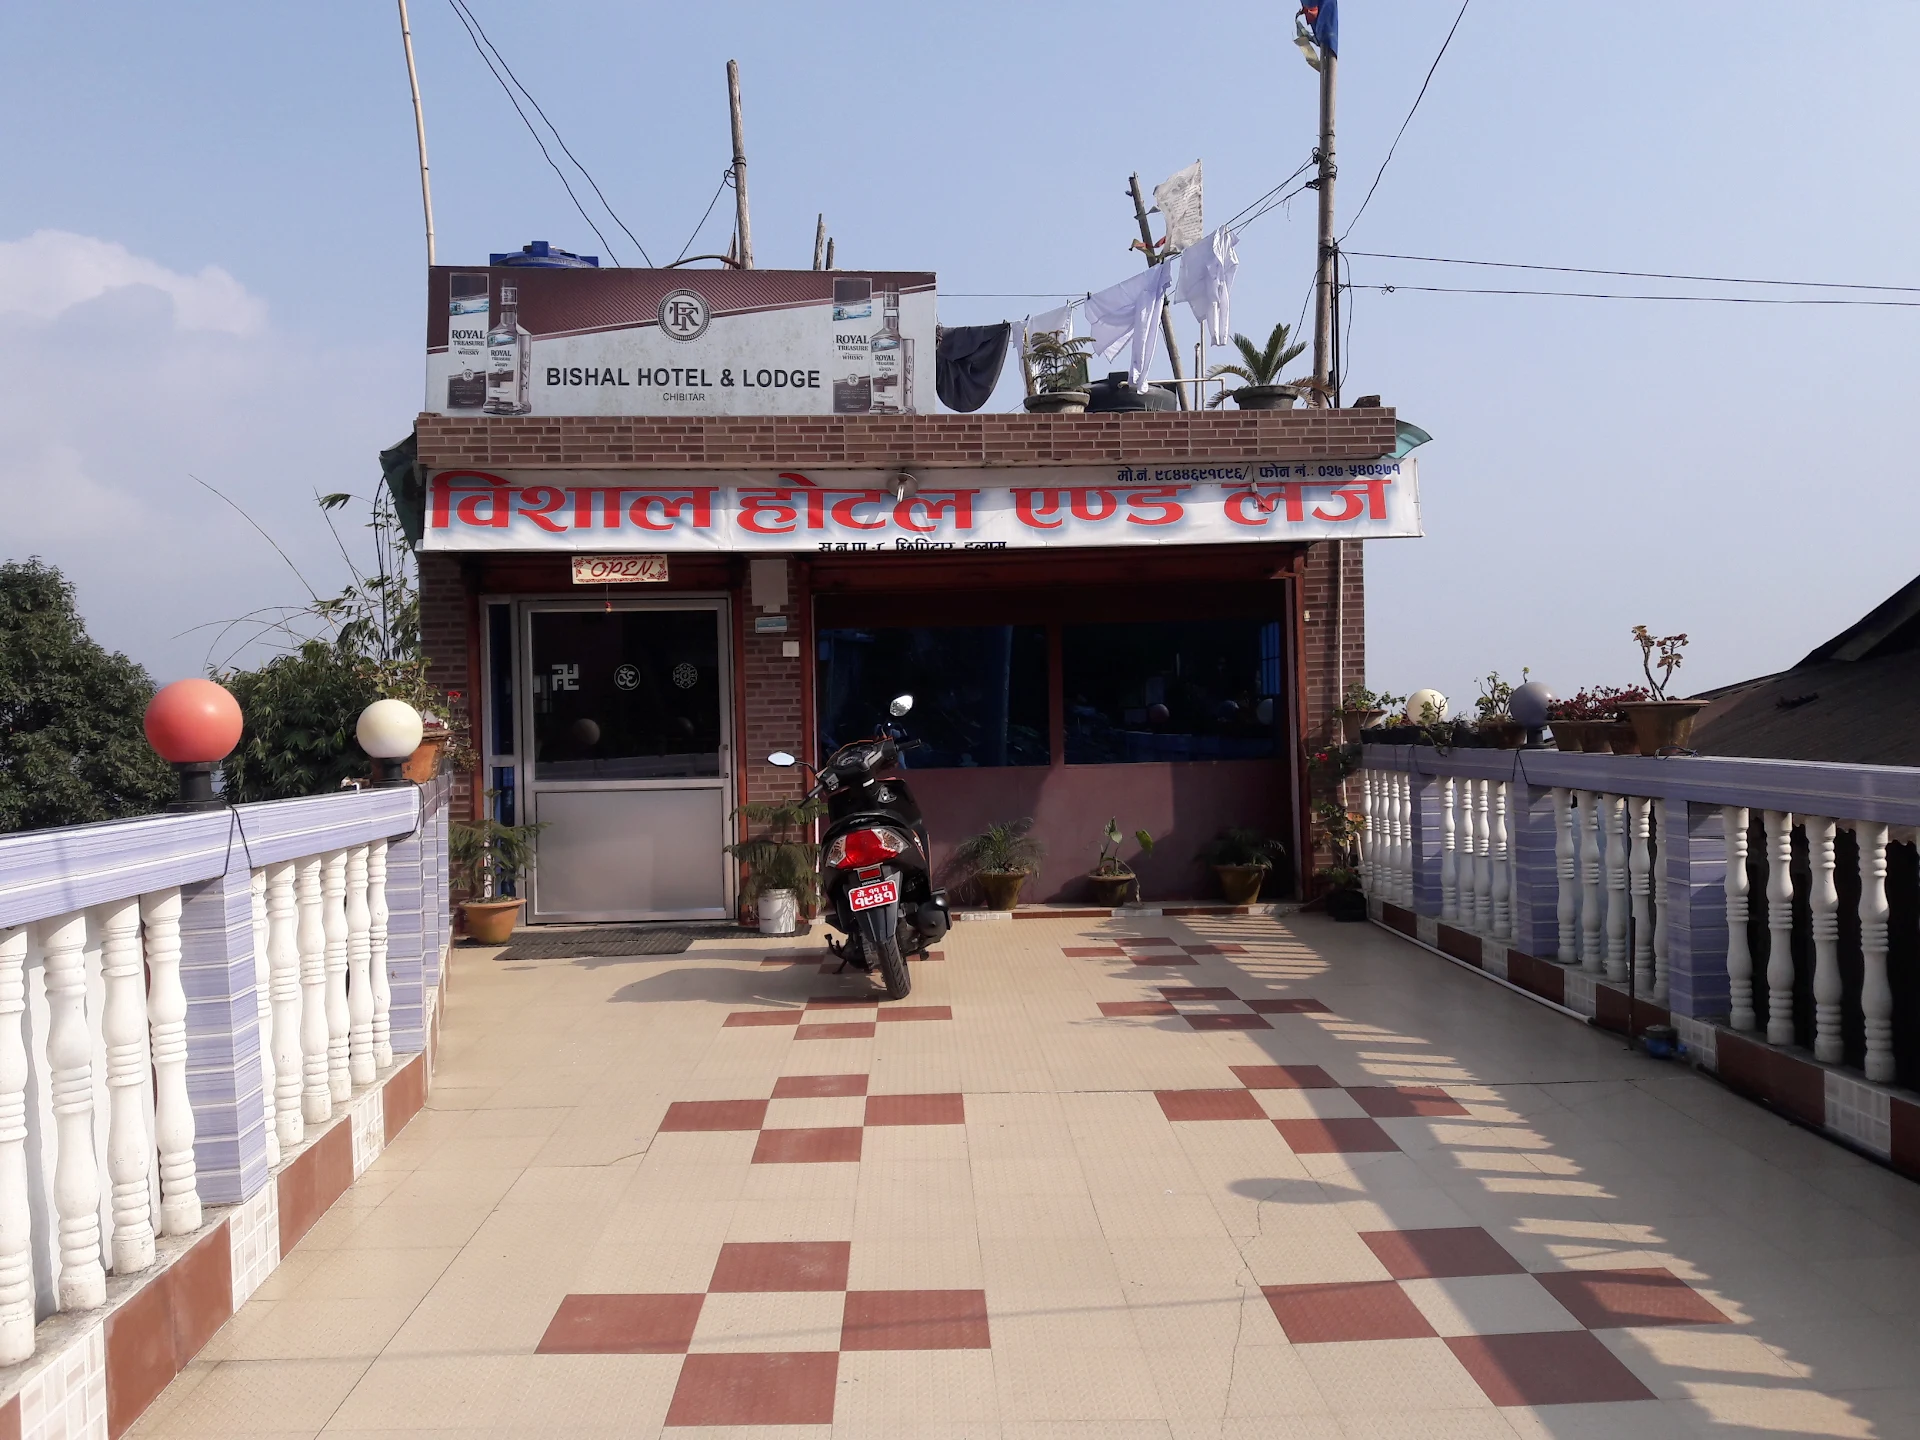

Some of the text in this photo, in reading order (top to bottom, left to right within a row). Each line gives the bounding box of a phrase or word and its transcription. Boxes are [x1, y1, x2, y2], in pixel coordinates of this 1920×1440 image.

[451, 329, 486, 340] ROYAL
[836, 335, 869, 345] ROYAL
[546, 367, 821, 389] BISHAL HOTEL & LODGE
[662, 391, 706, 402] CHIBITAR
[1259, 463, 1290, 478] फोन
[429, 470, 720, 533] विशाल
[736, 473, 981, 534] होटल
[1010, 485, 1192, 530] एण्ड
[591, 560, 654, 577] OPEN
